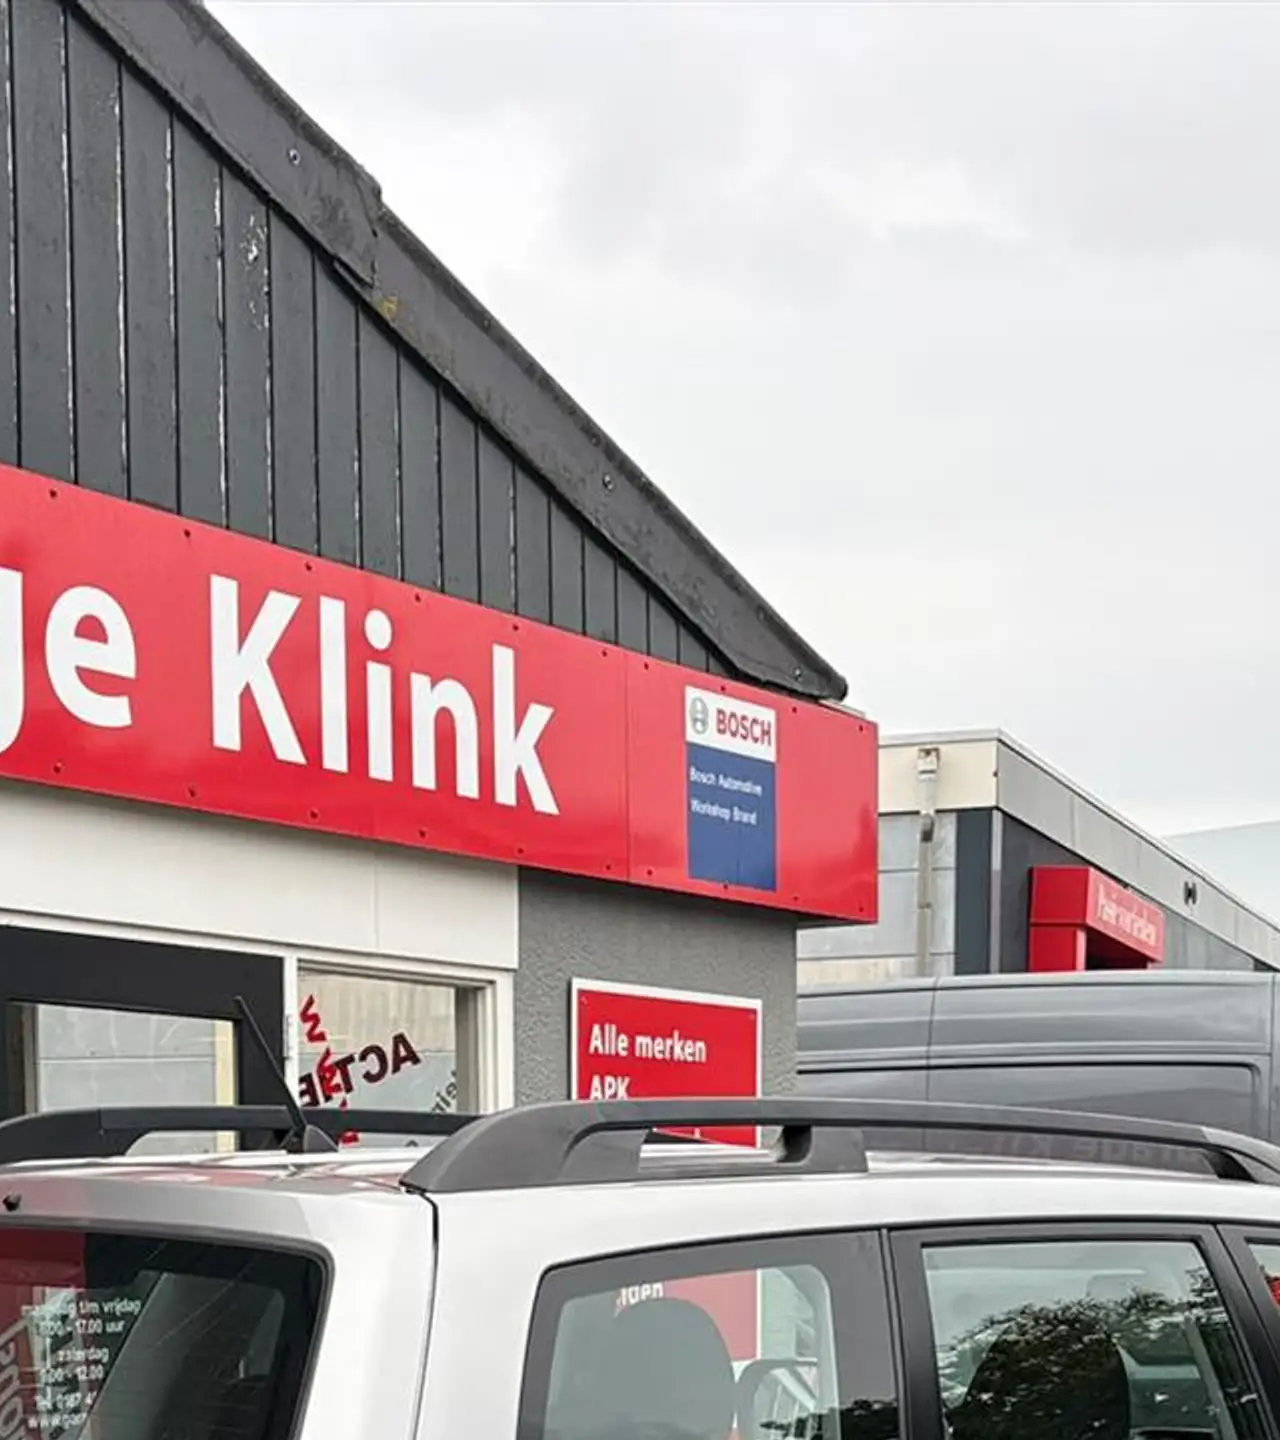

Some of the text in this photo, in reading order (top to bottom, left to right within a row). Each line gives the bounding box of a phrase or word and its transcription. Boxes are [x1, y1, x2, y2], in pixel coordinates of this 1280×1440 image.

[210, 573, 561, 816] Klink
[716, 707, 772, 746] BOSCH
[690, 766, 763, 797] Bosch Automotive
[690, 800, 757, 826] Workshop Brand
[589, 1023, 707, 1063] Alle merken
[590, 1075, 631, 1100] APK
[101, 1298, 141, 1316] vrijdag
